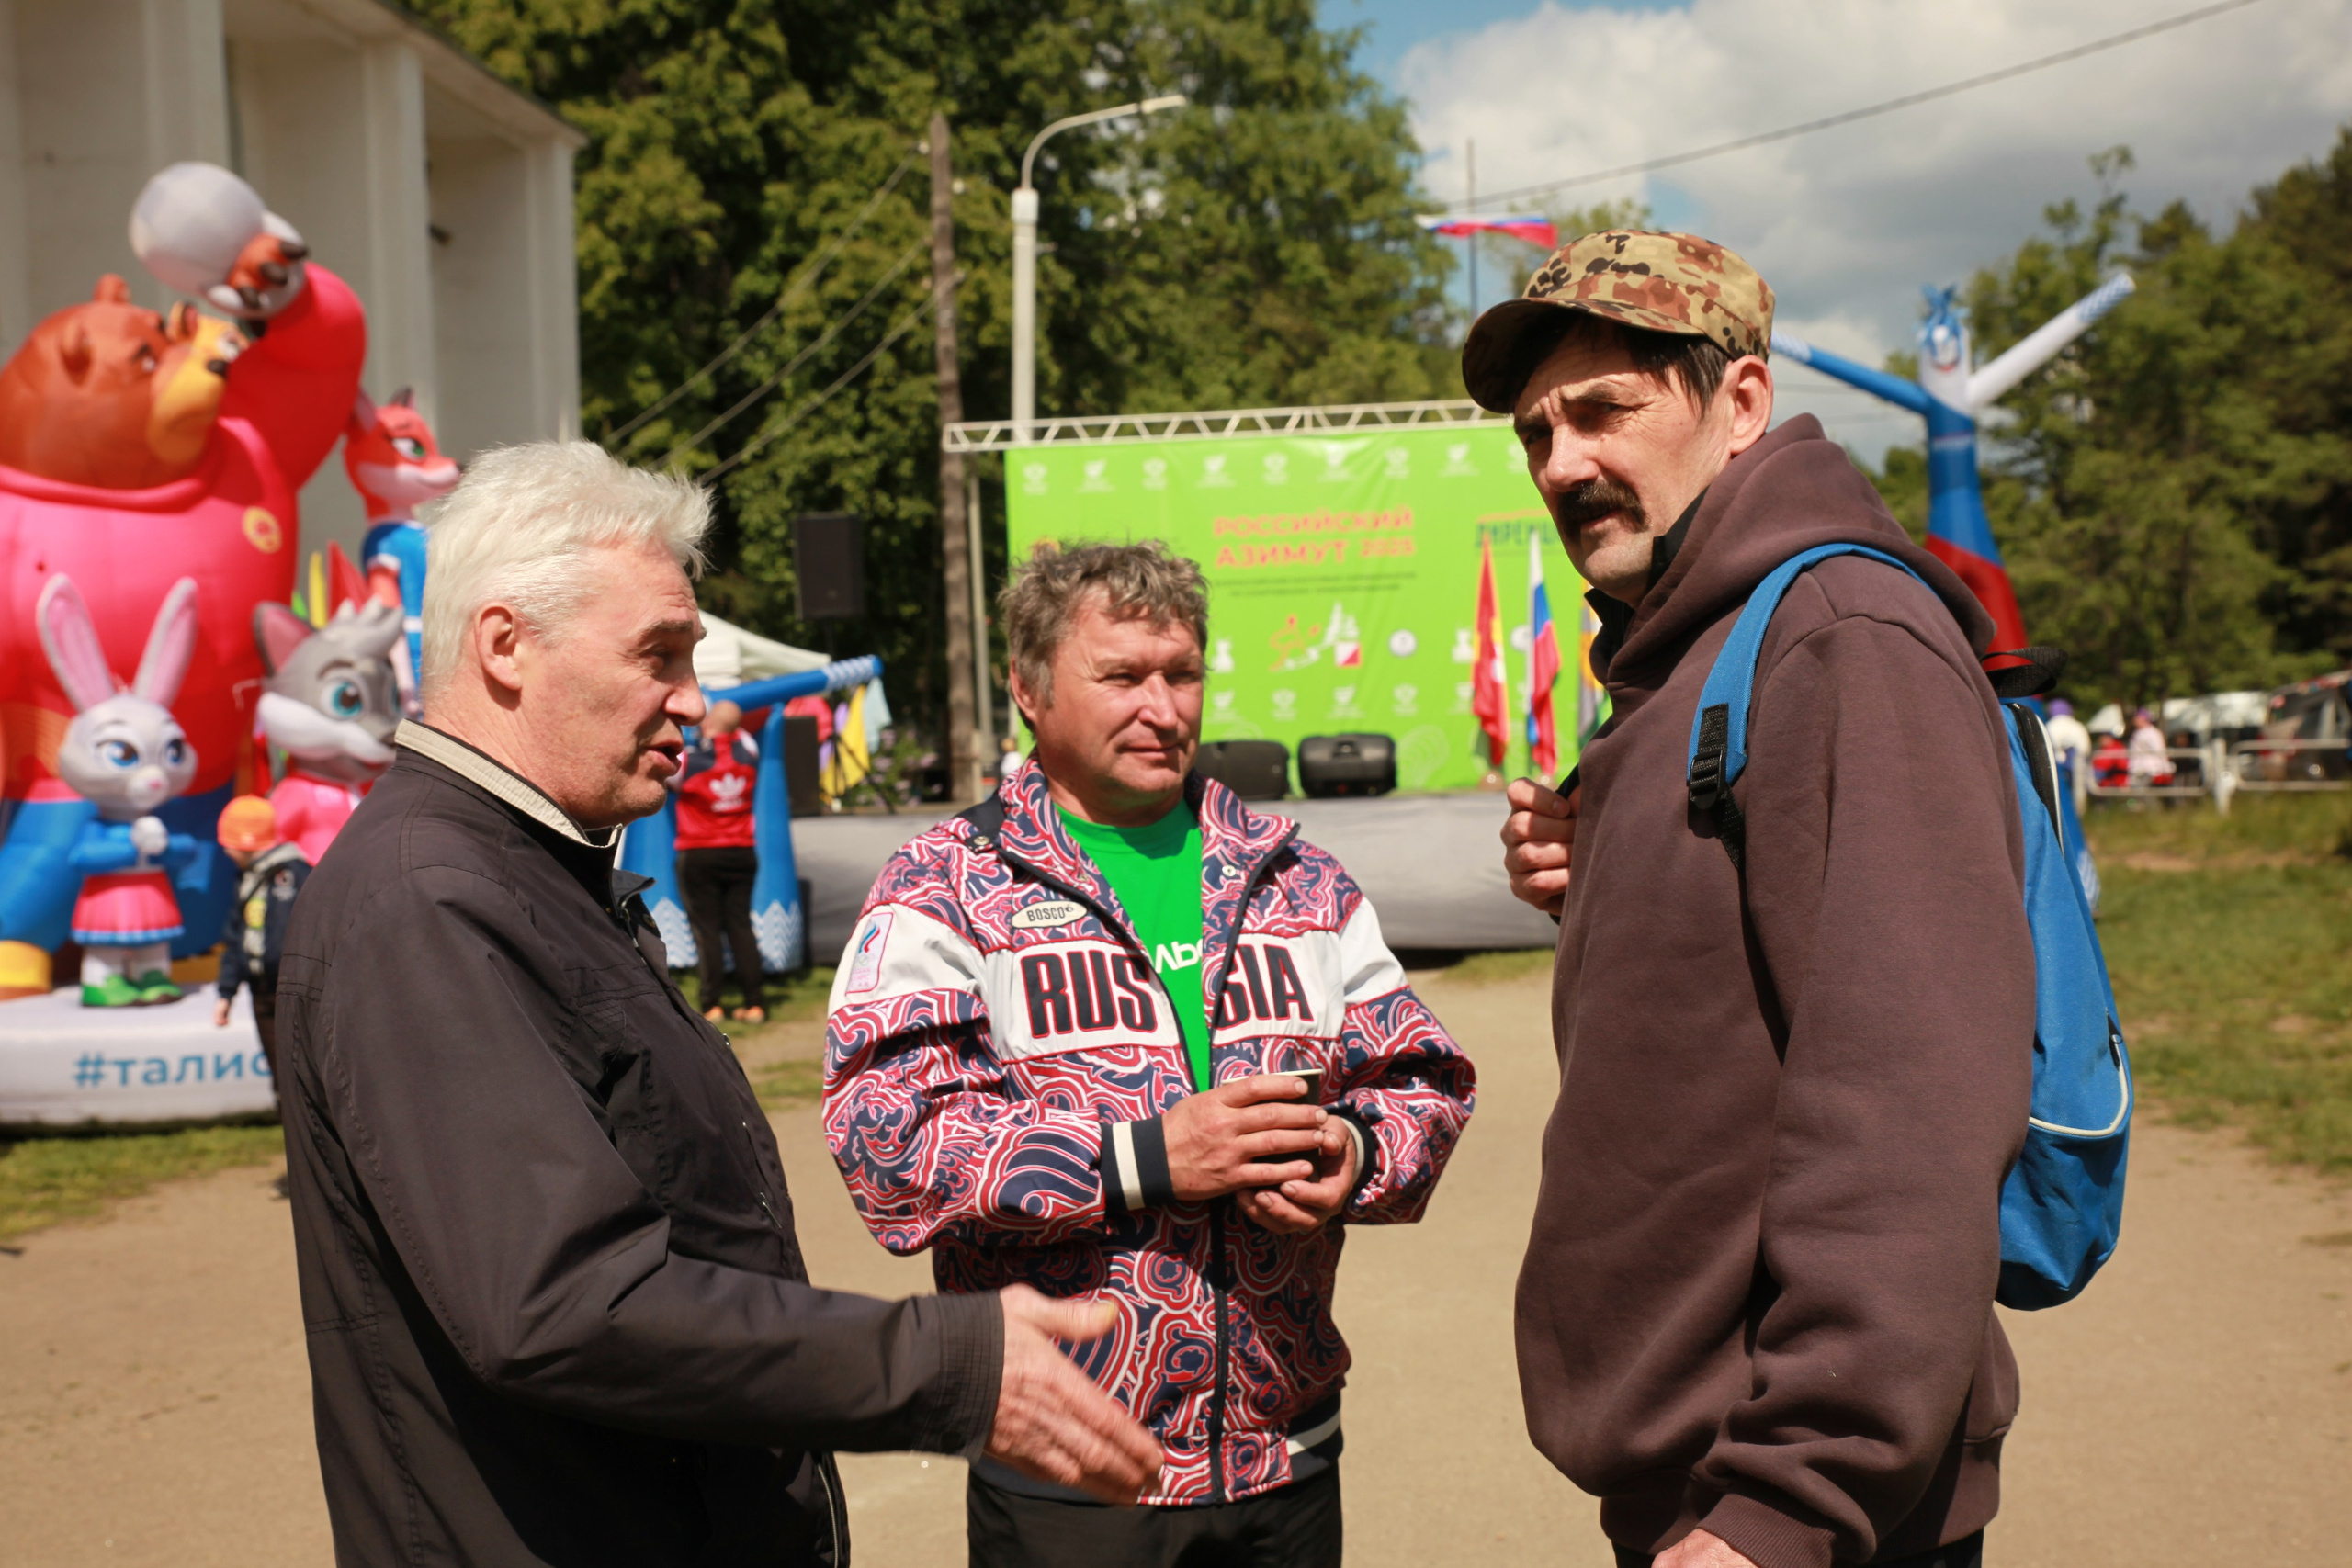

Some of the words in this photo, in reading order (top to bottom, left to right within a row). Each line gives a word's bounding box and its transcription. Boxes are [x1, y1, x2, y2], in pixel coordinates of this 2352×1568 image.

[1214, 505, 1413, 538] РОССИЙСКИЙ
[1216, 539, 1348, 568] АЗИМУТ
[1025, 906, 1066, 922] BOSCO
